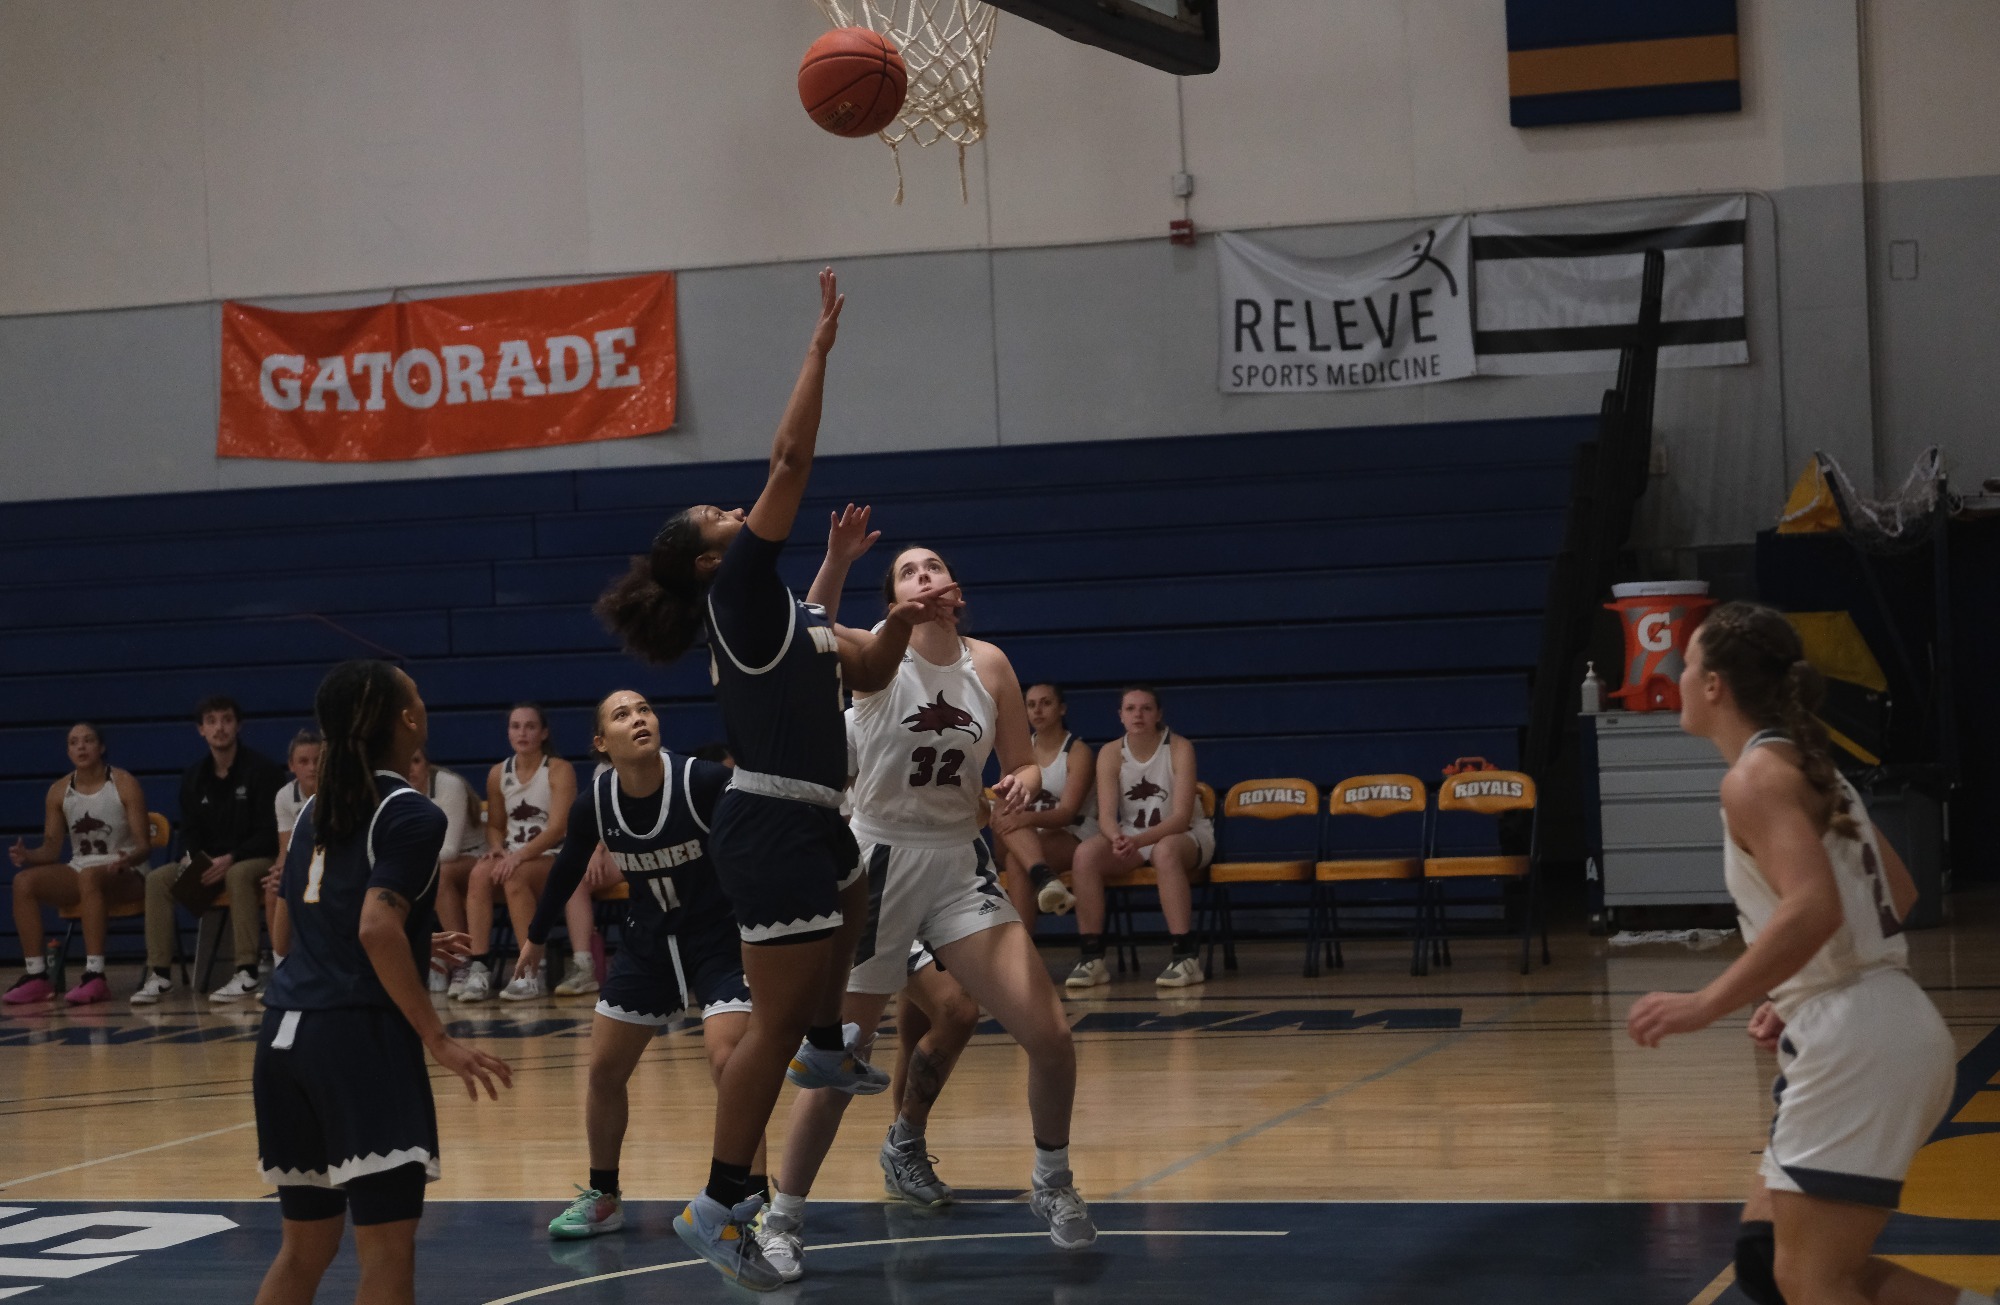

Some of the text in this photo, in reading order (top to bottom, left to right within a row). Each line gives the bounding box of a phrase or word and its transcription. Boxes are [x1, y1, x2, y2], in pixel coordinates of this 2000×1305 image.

[1235, 288, 1437, 352] RELEVE
[259, 327, 641, 411] GATORADE
[1232, 355, 1440, 387] SPORTS MEDICINE
[1637, 611, 1672, 652] G
[909, 746, 965, 787] 32
[1239, 788, 1306, 806] ROYALS
[1345, 785, 1412, 803] ROYALS
[1455, 781, 1522, 799] ROYALS
[609, 838, 703, 872] WARNER
[647, 876, 681, 913] 11
